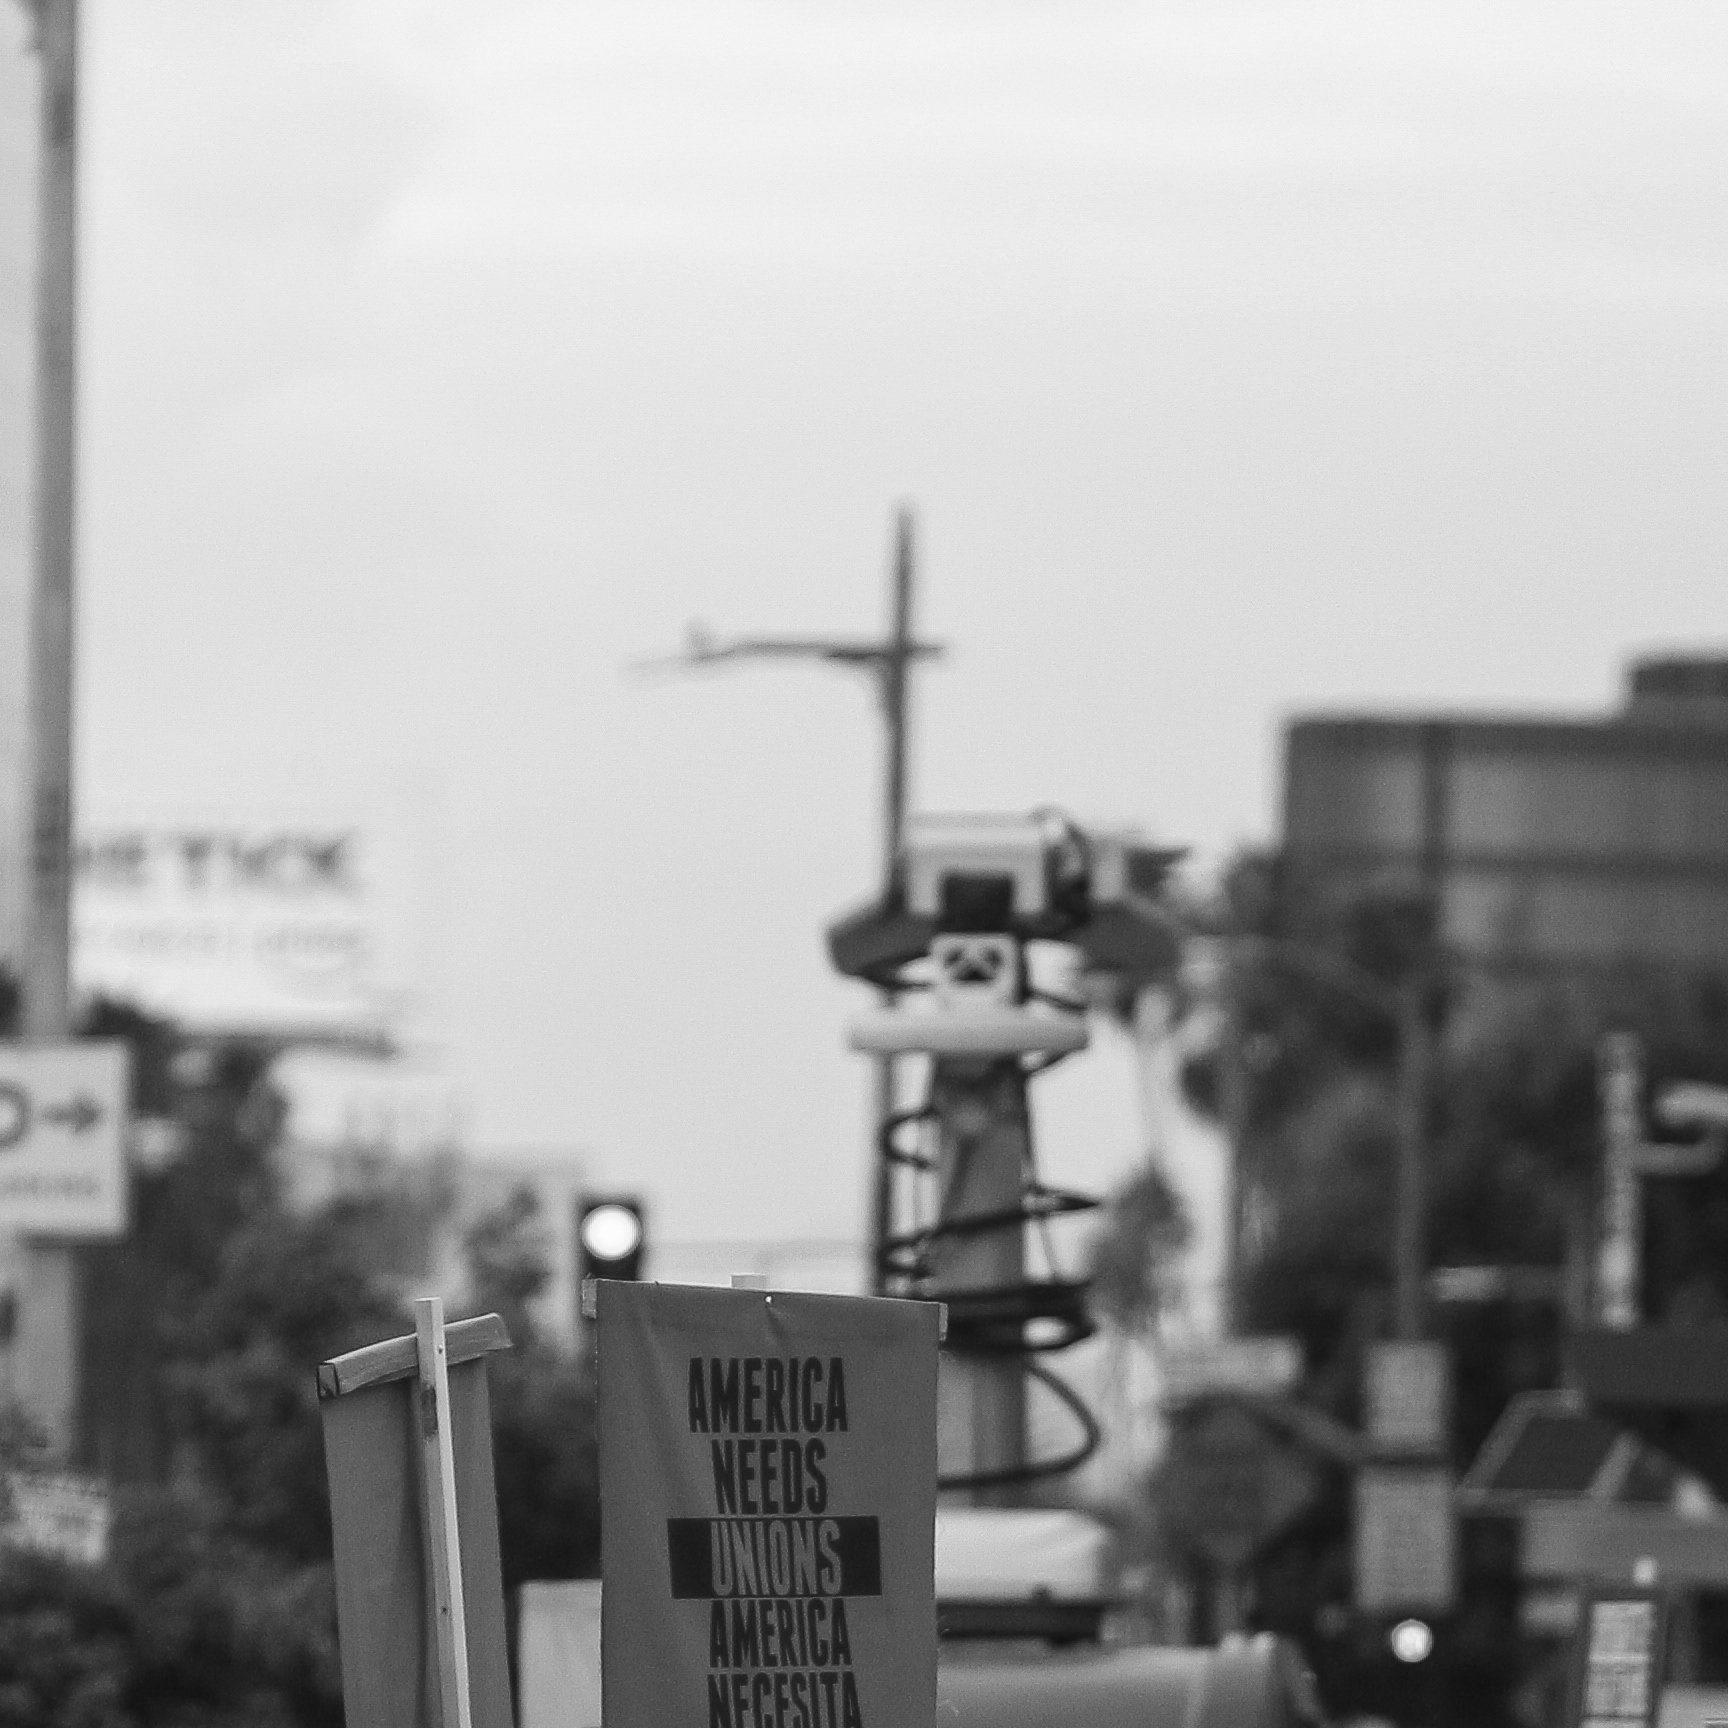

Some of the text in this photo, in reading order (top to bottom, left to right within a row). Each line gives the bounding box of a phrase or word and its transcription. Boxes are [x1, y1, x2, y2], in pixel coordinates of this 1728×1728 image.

[689, 1356, 848, 1433] AMERICA
[711, 1437, 827, 1515] NEEDS
[711, 1519, 842, 1596] UNIONS
[710, 1597, 853, 1668] AMERICA
